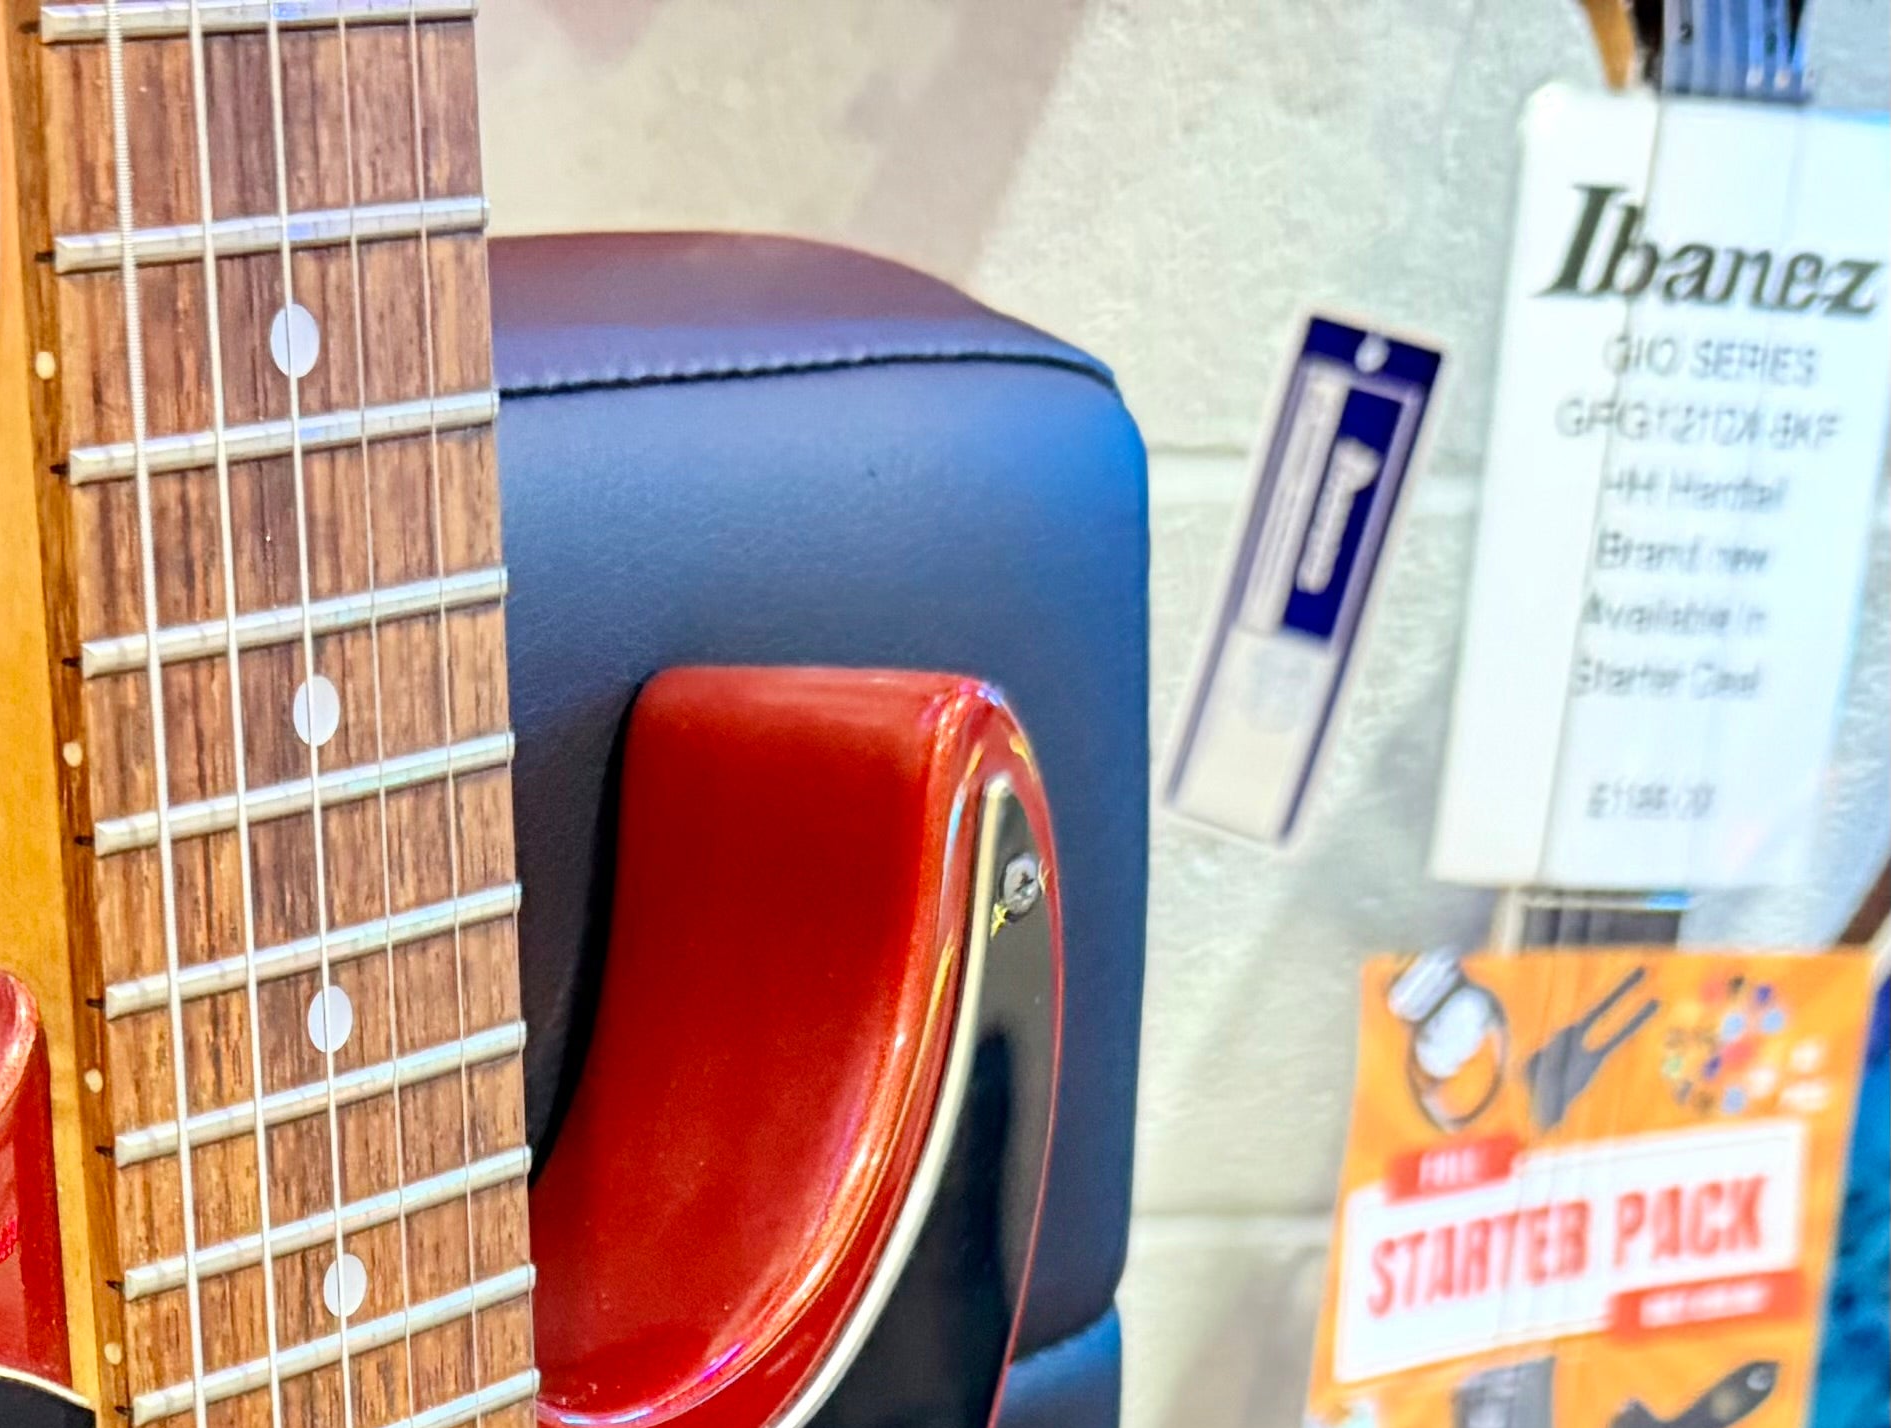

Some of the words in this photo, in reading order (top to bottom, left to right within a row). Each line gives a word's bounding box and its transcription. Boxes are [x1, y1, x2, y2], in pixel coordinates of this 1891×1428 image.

[1531, 184, 1881, 316] Ibanez
[1604, 335, 1678, 377] GIO
[1691, 339, 1818, 385] SERIES
[1596, 530, 1702, 572] Brand
[1581, 593, 1730, 634] Available
[1367, 1201, 1589, 1318] STARTER
[1615, 1174, 1768, 1266] PACK
